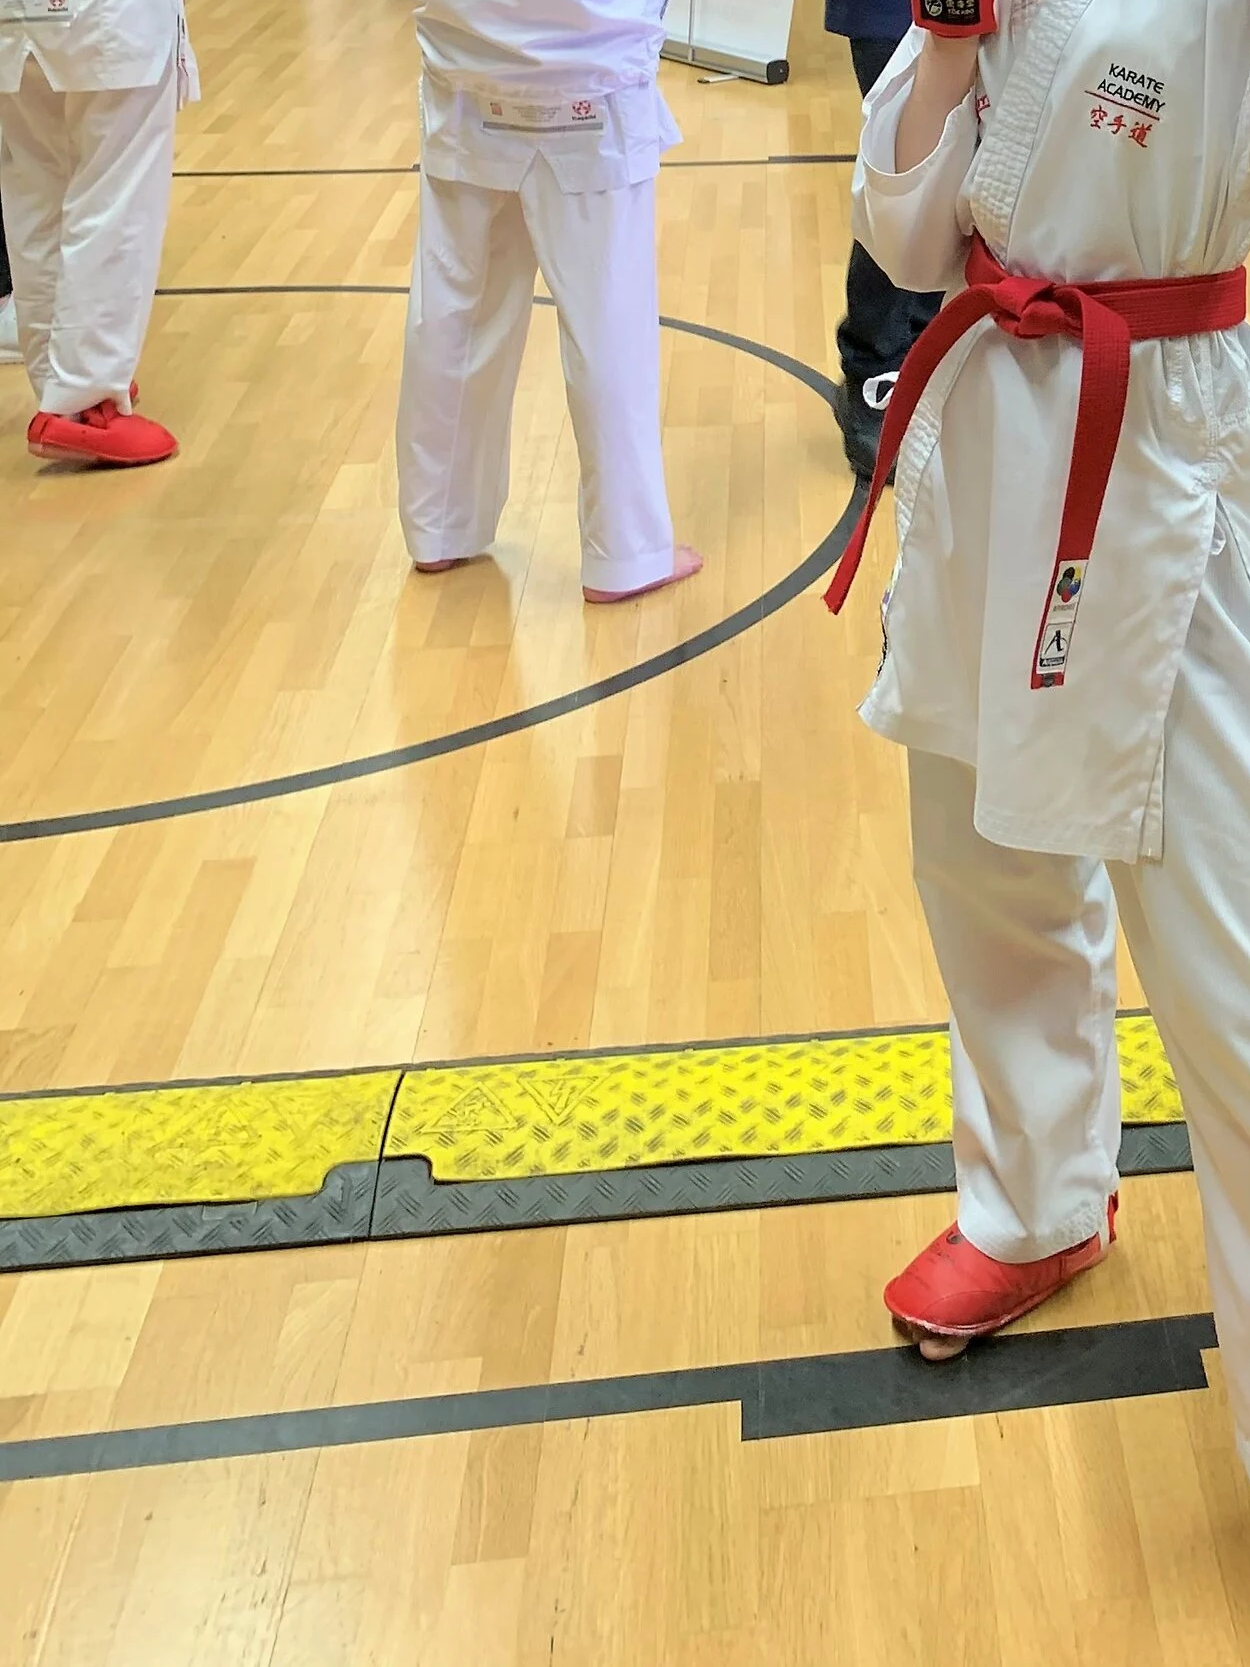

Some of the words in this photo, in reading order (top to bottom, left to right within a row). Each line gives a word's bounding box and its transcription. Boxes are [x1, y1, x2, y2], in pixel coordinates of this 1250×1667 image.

[1097, 78, 1166, 113] ACADEMY
[1108, 62, 1165, 95] KARATE
[1089, 104, 1153, 149] 空手道
